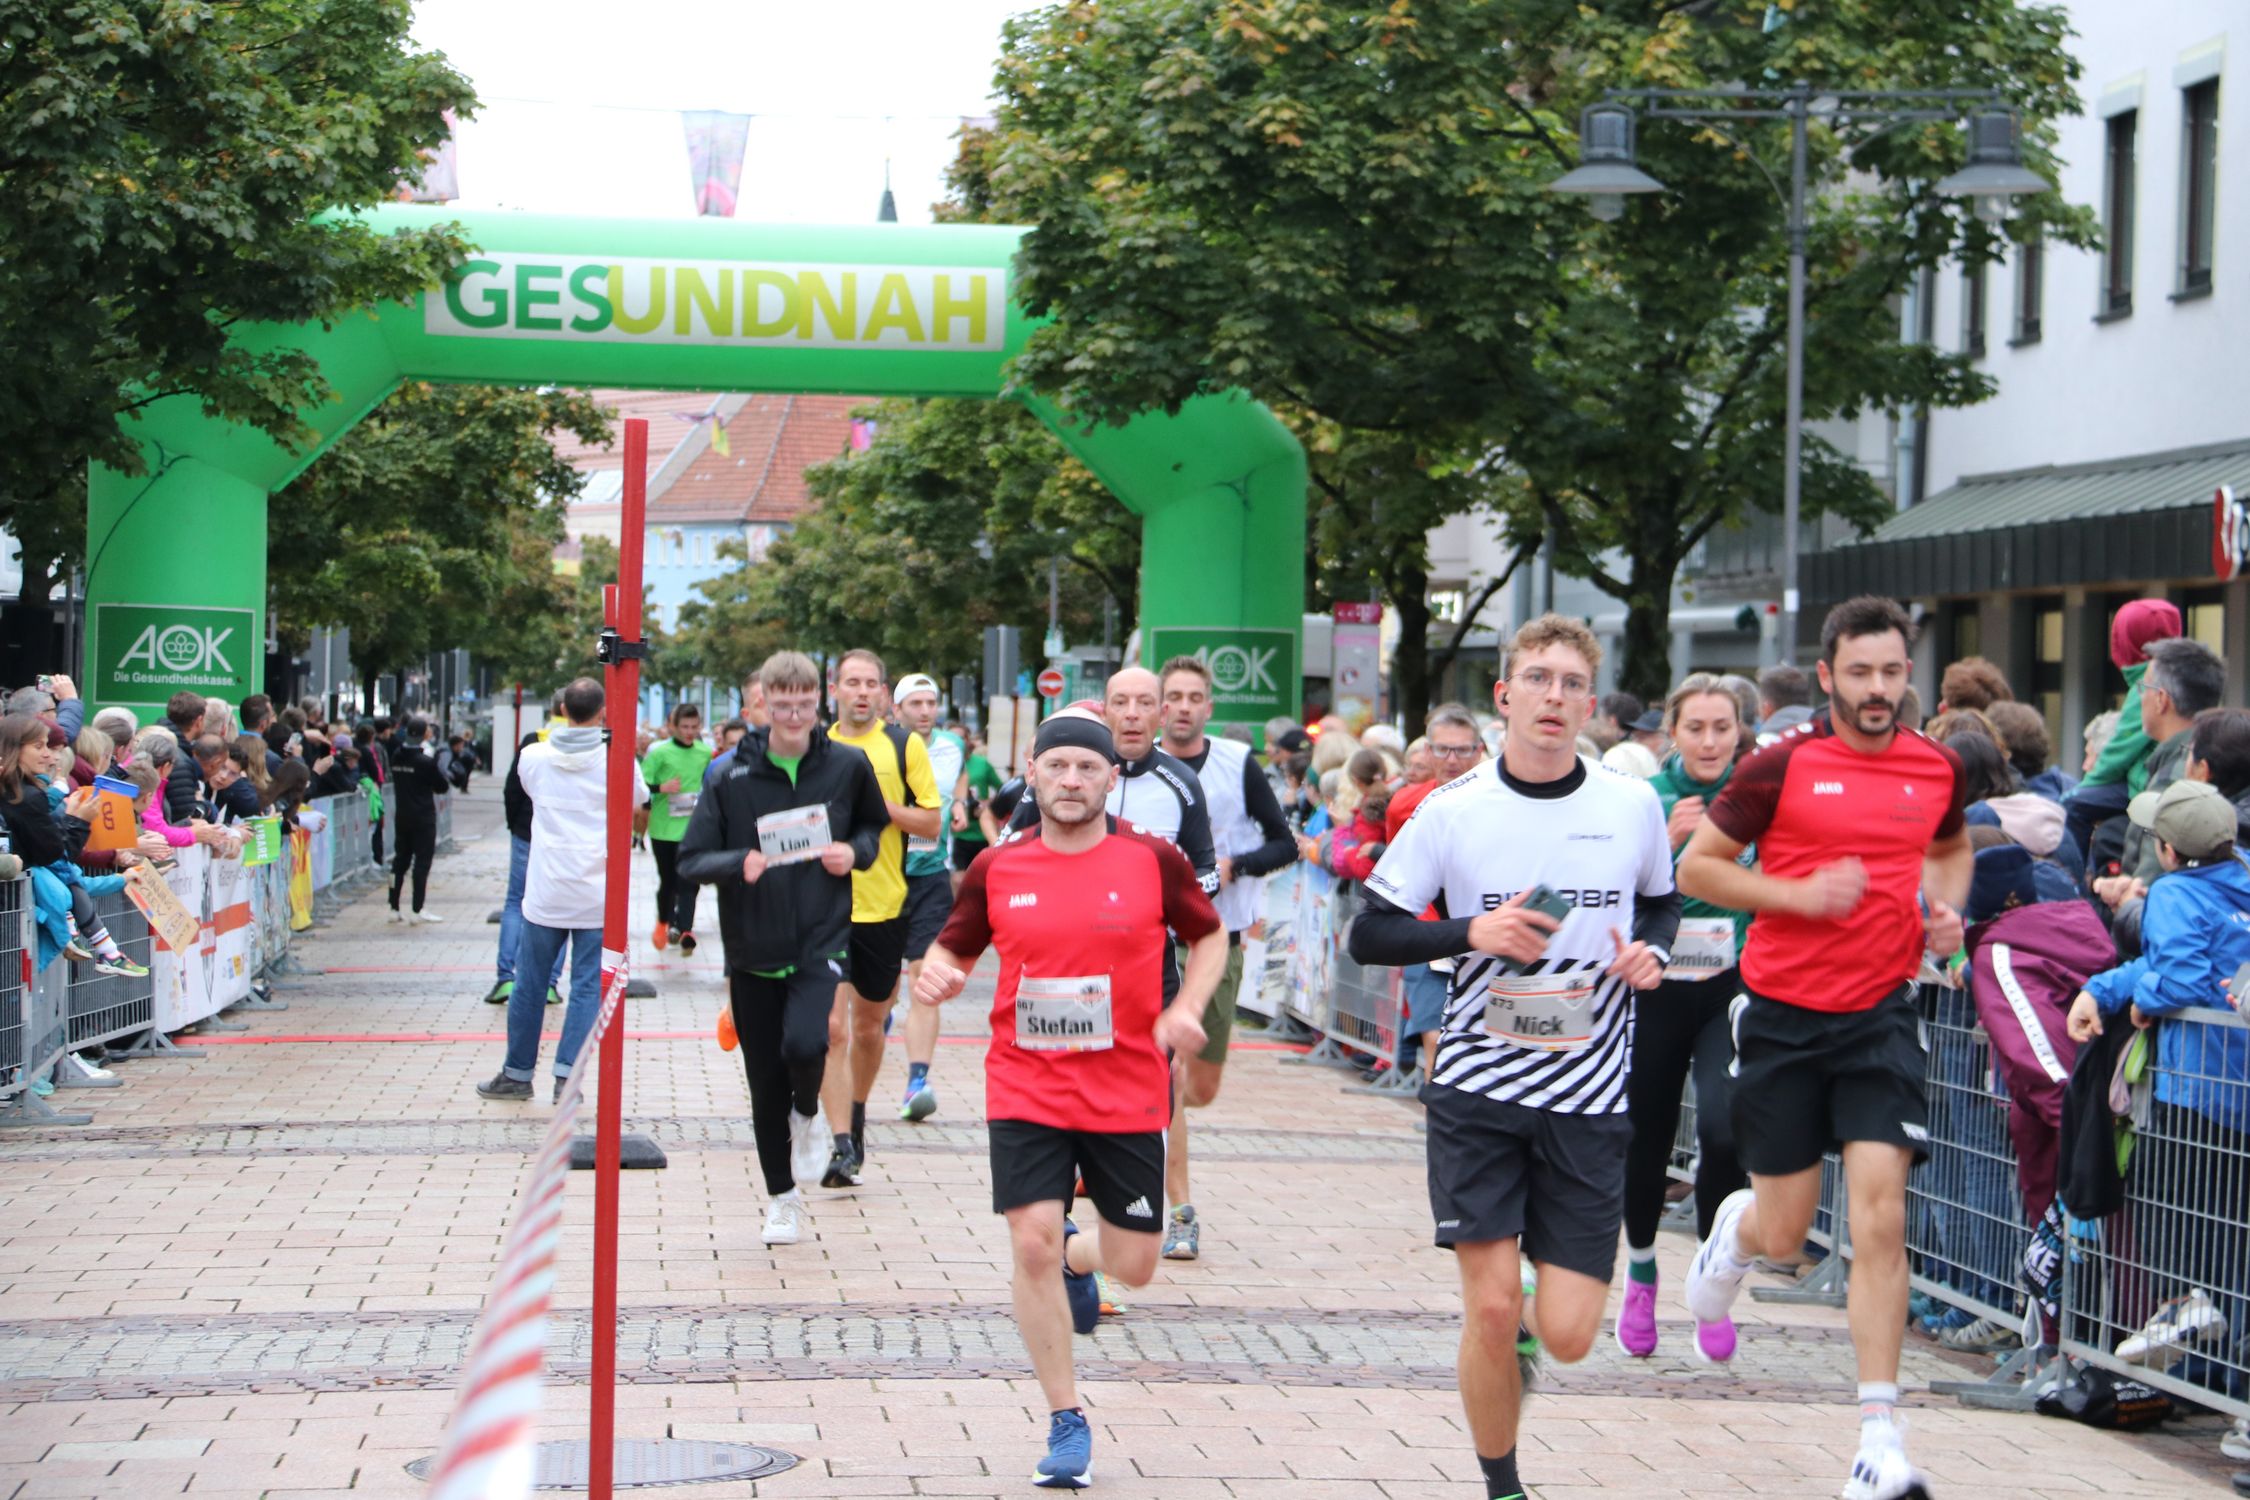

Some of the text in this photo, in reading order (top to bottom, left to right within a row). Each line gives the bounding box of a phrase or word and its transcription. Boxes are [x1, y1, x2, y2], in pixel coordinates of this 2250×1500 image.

[445, 259, 987, 344] GESUNDNAH
[117, 624, 234, 673] AOK
[113, 671, 236, 686] Die Gesundheitskasse.
[1812, 781, 1844, 795] JAKO
[780, 839, 810, 853] Lian
[1009, 893, 1037, 908] JAKO
[1671, 951, 1722, 967] omina
[1027, 1015, 1093, 1034] Stefan
[1513, 1015, 1564, 1036] Nick
